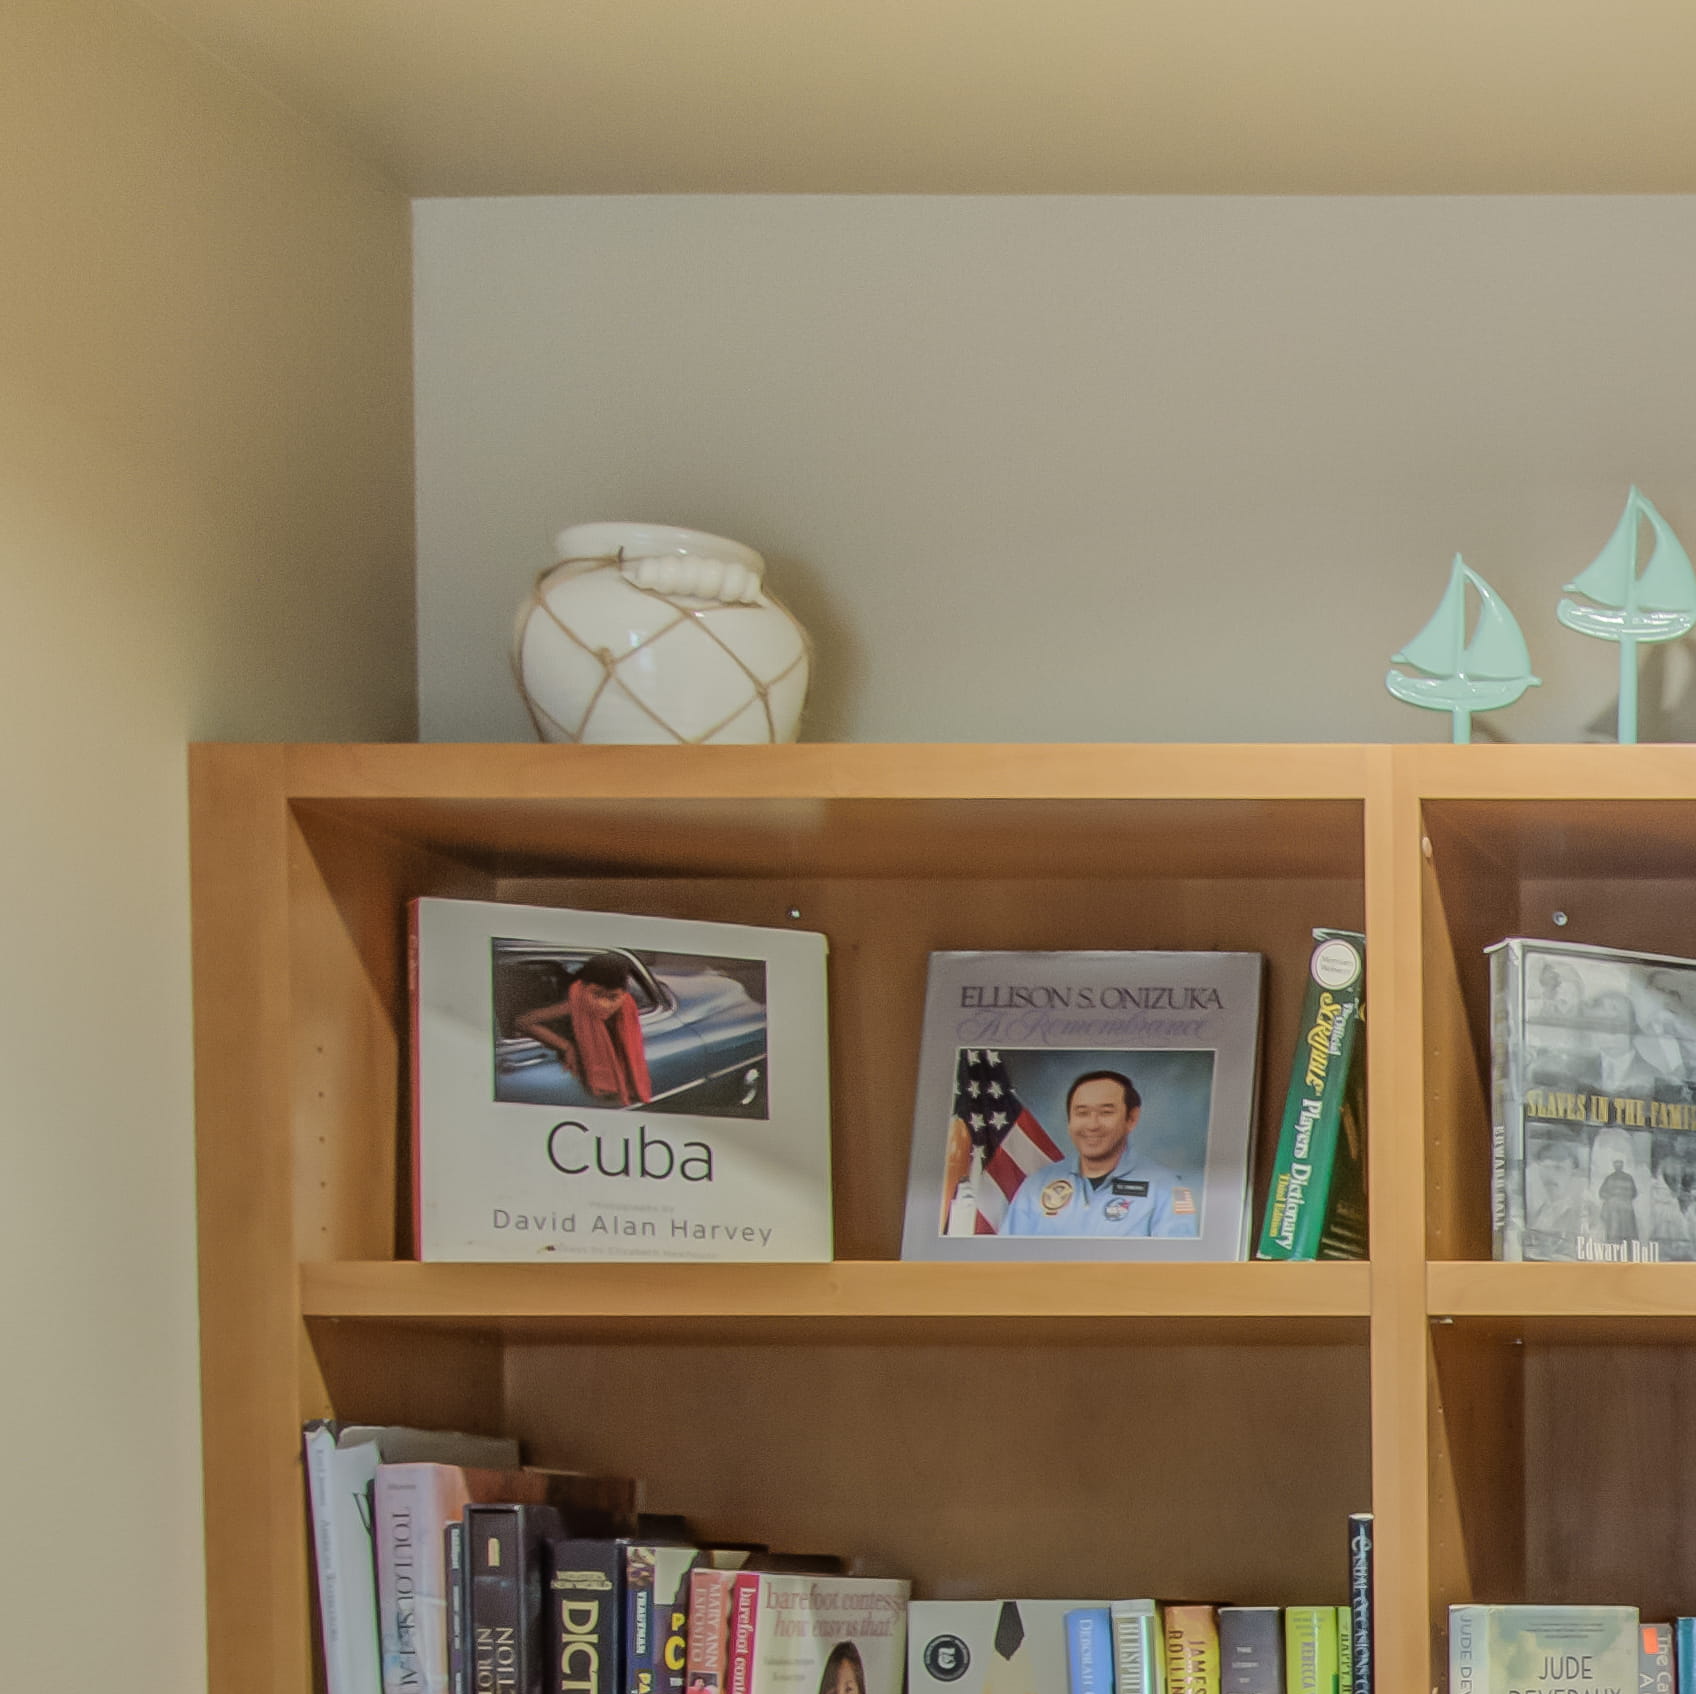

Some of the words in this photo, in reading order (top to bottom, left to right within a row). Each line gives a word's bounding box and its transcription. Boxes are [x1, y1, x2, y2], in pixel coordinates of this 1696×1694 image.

[960, 986, 1070, 1008] ELLISON
[1101, 986, 1224, 1009] ONIZUKA
[1525, 1090, 1586, 1121] SLAVES
[1590, 1096, 1608, 1122] IN
[1615, 1097, 1644, 1126] THE
[1294, 1099, 1322, 1158] Players
[547, 1121, 713, 1181] Cuba
[1276, 1163, 1312, 1249] Dictionary
[493, 1209, 576, 1232] David
[592, 1215, 656, 1236] Alan
[671, 1219, 772, 1246] Harvey
[734, 1587, 754, 1654] barefoot
[1538, 1656, 1592, 1680] JUDE
[1657, 1635, 1672, 1665] The
[1640, 1673, 1653, 1687] A
